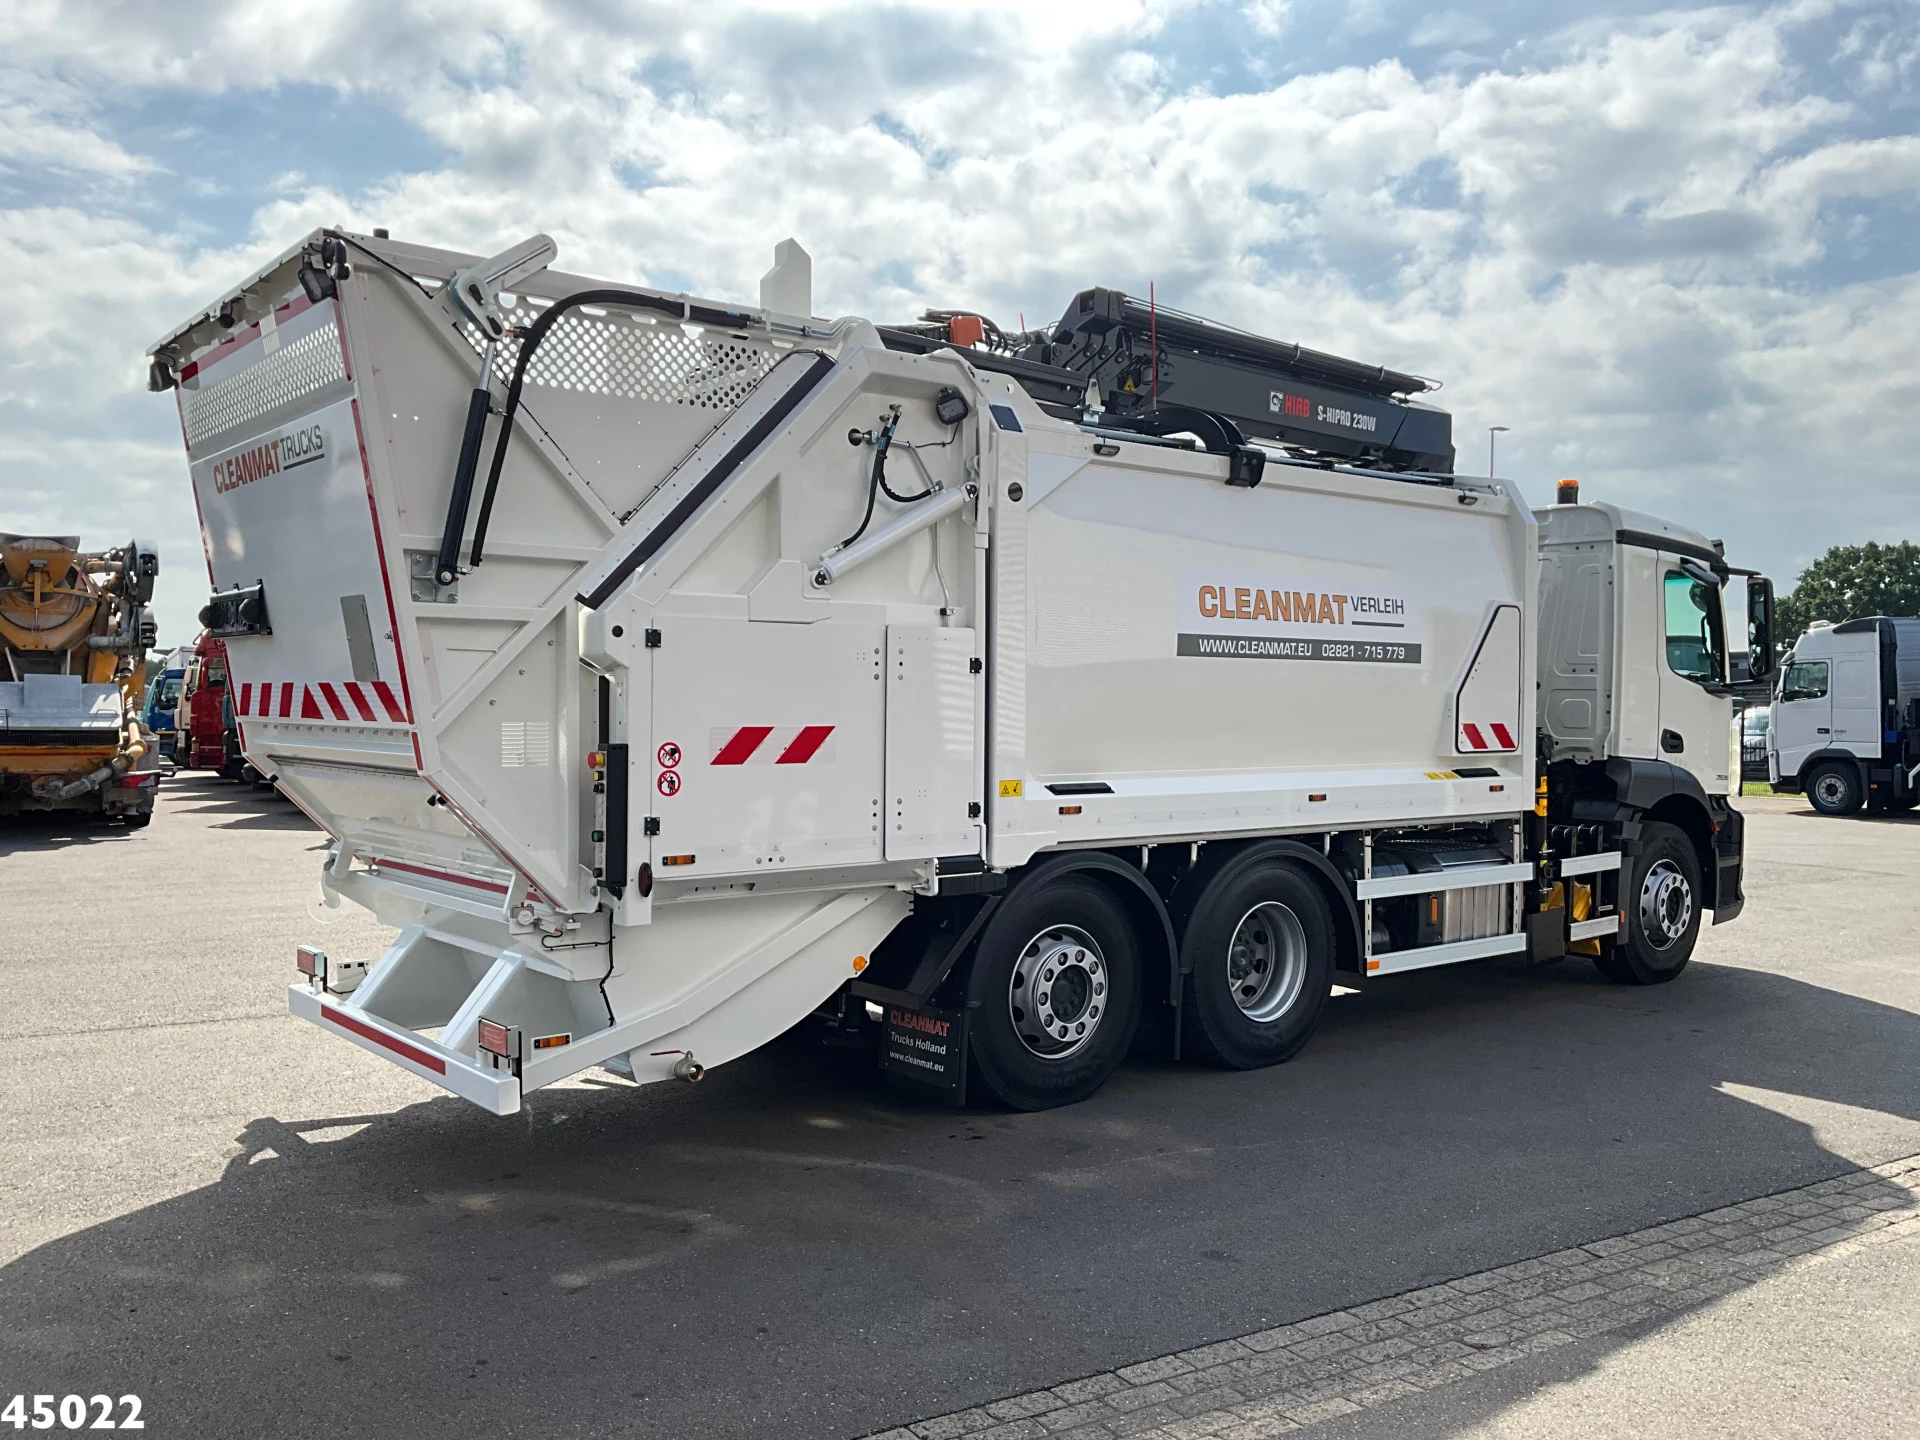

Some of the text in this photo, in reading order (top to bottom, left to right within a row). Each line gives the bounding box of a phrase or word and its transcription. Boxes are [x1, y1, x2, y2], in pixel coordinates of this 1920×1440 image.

[1285, 395, 1377, 432] HIAB S-HIPRO 230W
[213, 424, 324, 494] CLEANMAT TRUCKS
[1198, 585, 1405, 625] CLEANMAT VERLEIH
[1198, 639, 1312, 656] WWW.CLEANMAT.EU
[1322, 644, 1355, 658] 02821
[1364, 646, 1383, 658] 715
[1386, 646, 1405, 659] 779
[890, 1009, 950, 1037] CLEANMAT
[891, 1031, 947, 1055] Trucks Holland
[889, 1050, 944, 1072] www.cleanmat.eu
